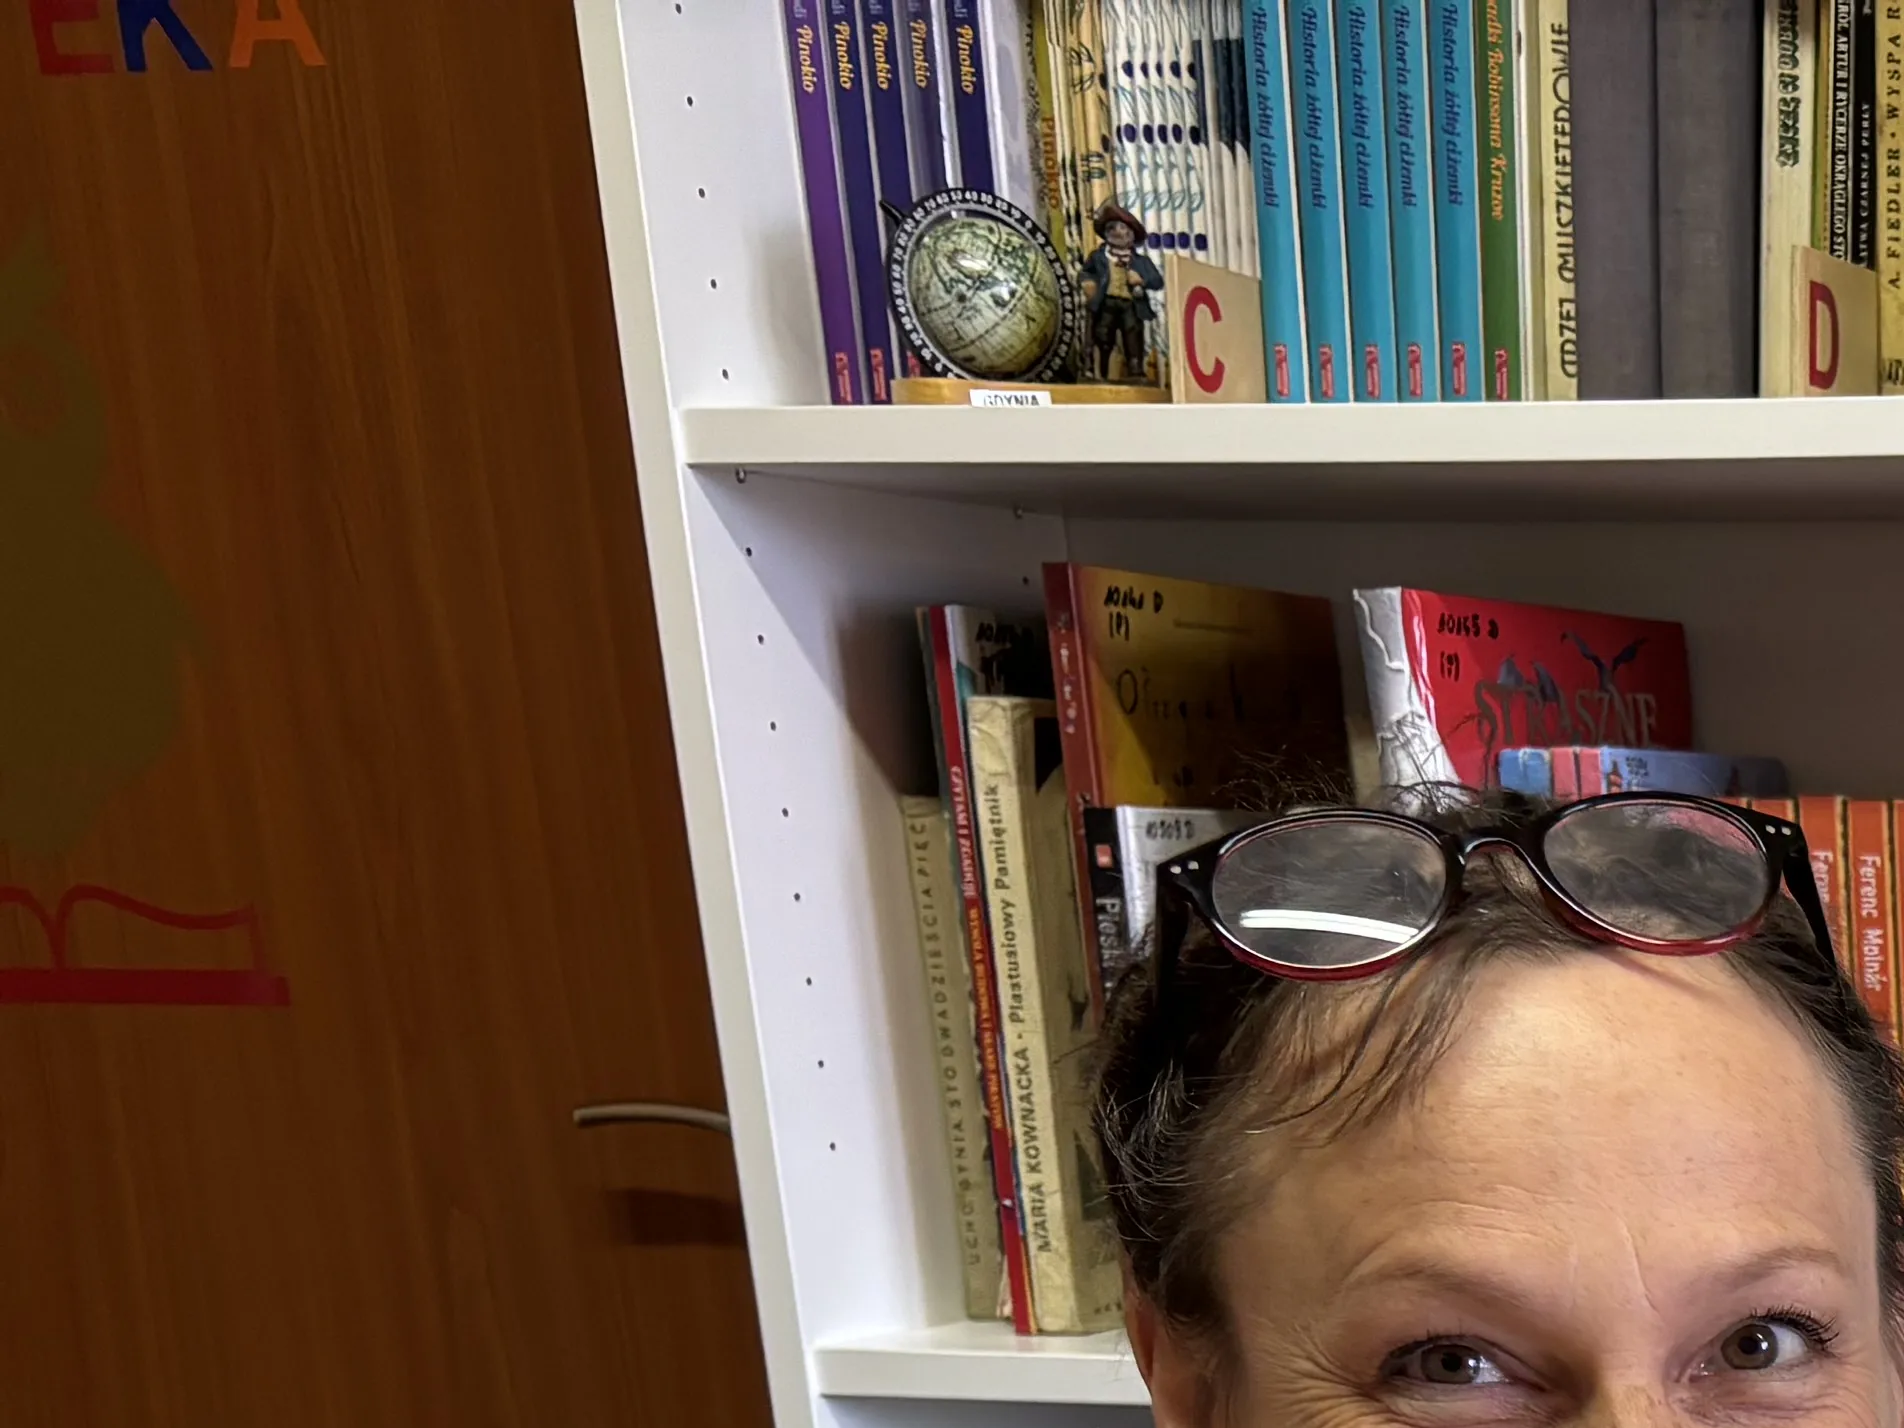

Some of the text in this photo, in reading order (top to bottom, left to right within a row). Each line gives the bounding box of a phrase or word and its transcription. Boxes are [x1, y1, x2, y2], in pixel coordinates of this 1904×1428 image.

[797, 25, 816, 94] Pinokio
[832, 21, 855, 90] Pinokio
[956, 24, 977, 94] Pinokio
[1250, 7, 1272, 88] Historia
[1442, 4, 1459, 86] Historia
[1256, 93, 1275, 140] żółtej
[1442, 90, 1461, 138] żółtej
[1885, 33, 1902, 260] FIEDLER WYSPA
[1184, 286, 1225, 393] C
[1809, 280, 1840, 390] D
[984, 779, 1052, 1253] MARIA KOWNACKA Plastusiowy Pamiętnik
